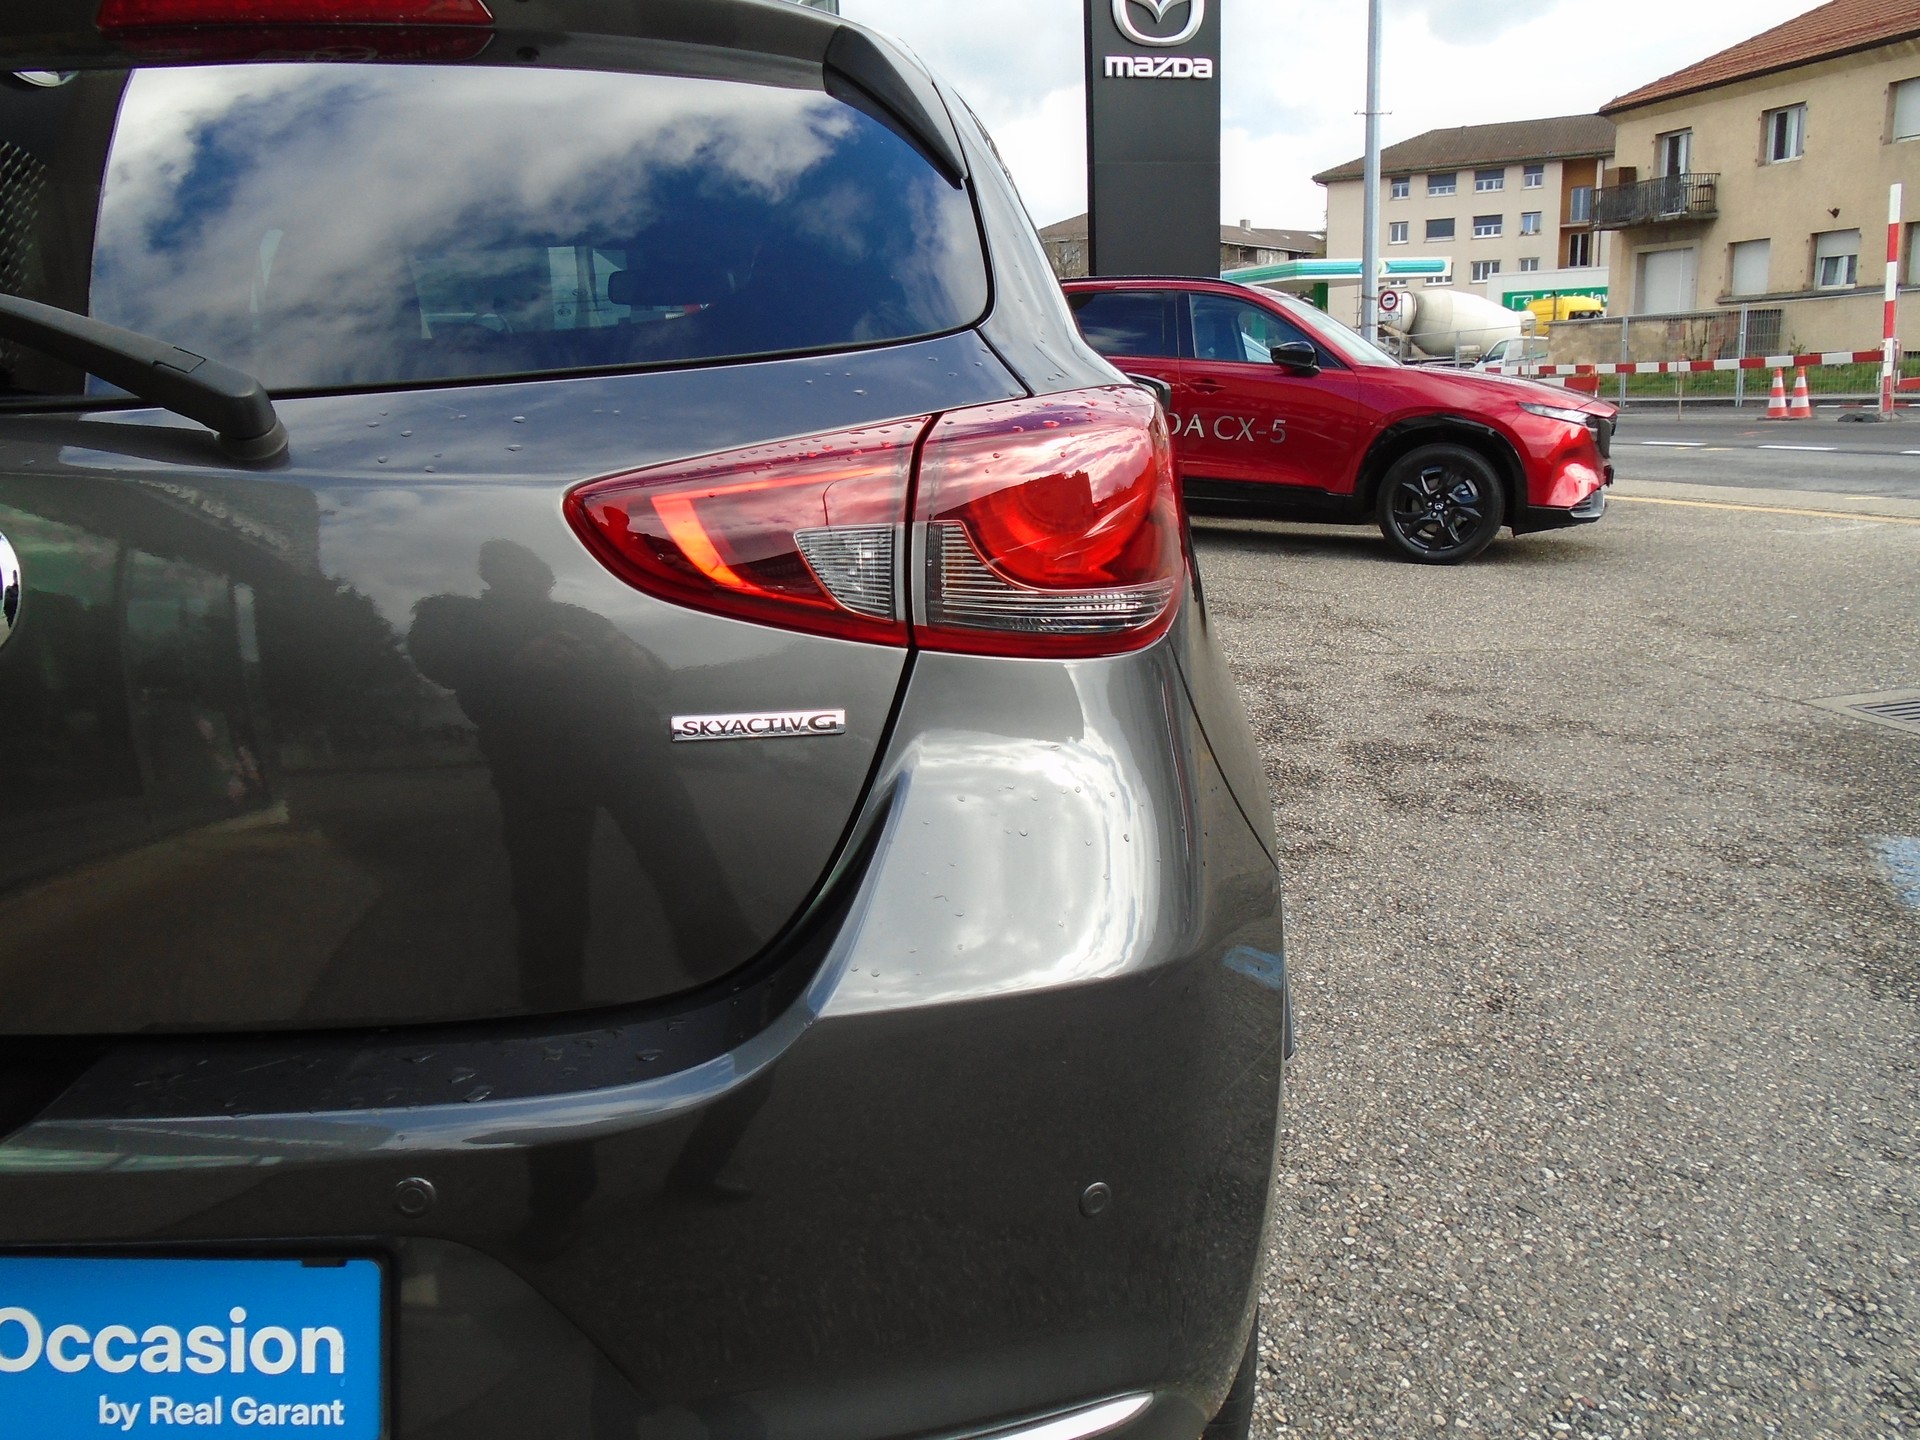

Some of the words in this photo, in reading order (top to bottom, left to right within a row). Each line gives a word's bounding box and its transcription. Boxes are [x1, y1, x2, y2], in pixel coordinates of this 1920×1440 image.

[1213, 415, 1287, 444] CX-5
[0, 1306, 345, 1374] Occasion
[99, 1394, 140, 1431] by
[150, 1396, 222, 1425] Real
[231, 1396, 345, 1426] Garant
